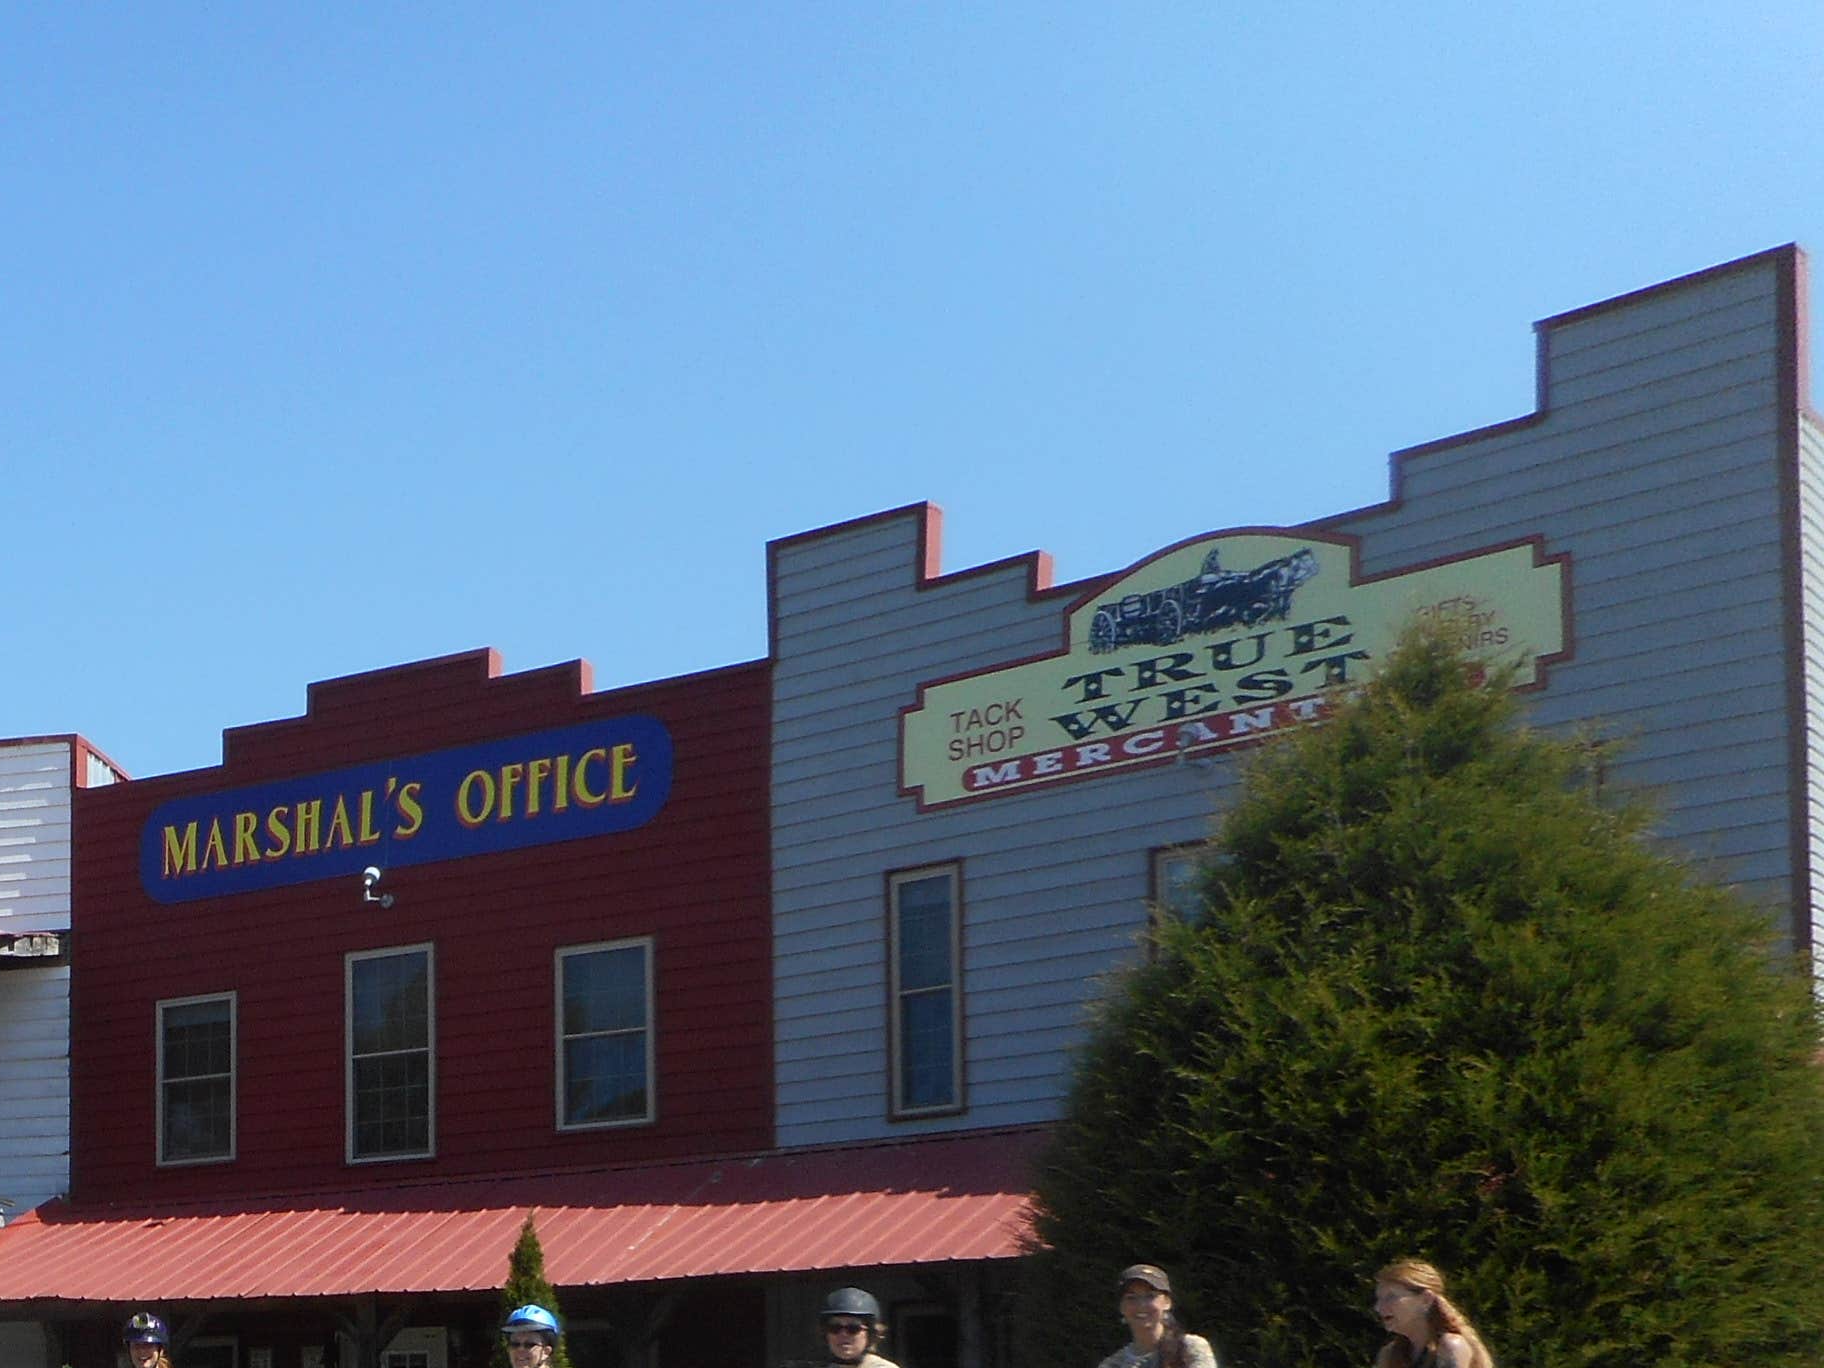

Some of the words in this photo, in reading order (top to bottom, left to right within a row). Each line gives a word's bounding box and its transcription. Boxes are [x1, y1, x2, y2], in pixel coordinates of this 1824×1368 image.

[1048, 650, 1371, 741] WEST
[1061, 615, 1355, 704] TRUE
[948, 725, 1025, 762] SHOP
[950, 698, 1024, 734] TACK
[973, 691, 1366, 788] MERCANT
[160, 776, 425, 879] MARSHAL'S
[456, 742, 639, 831] OFFICE
